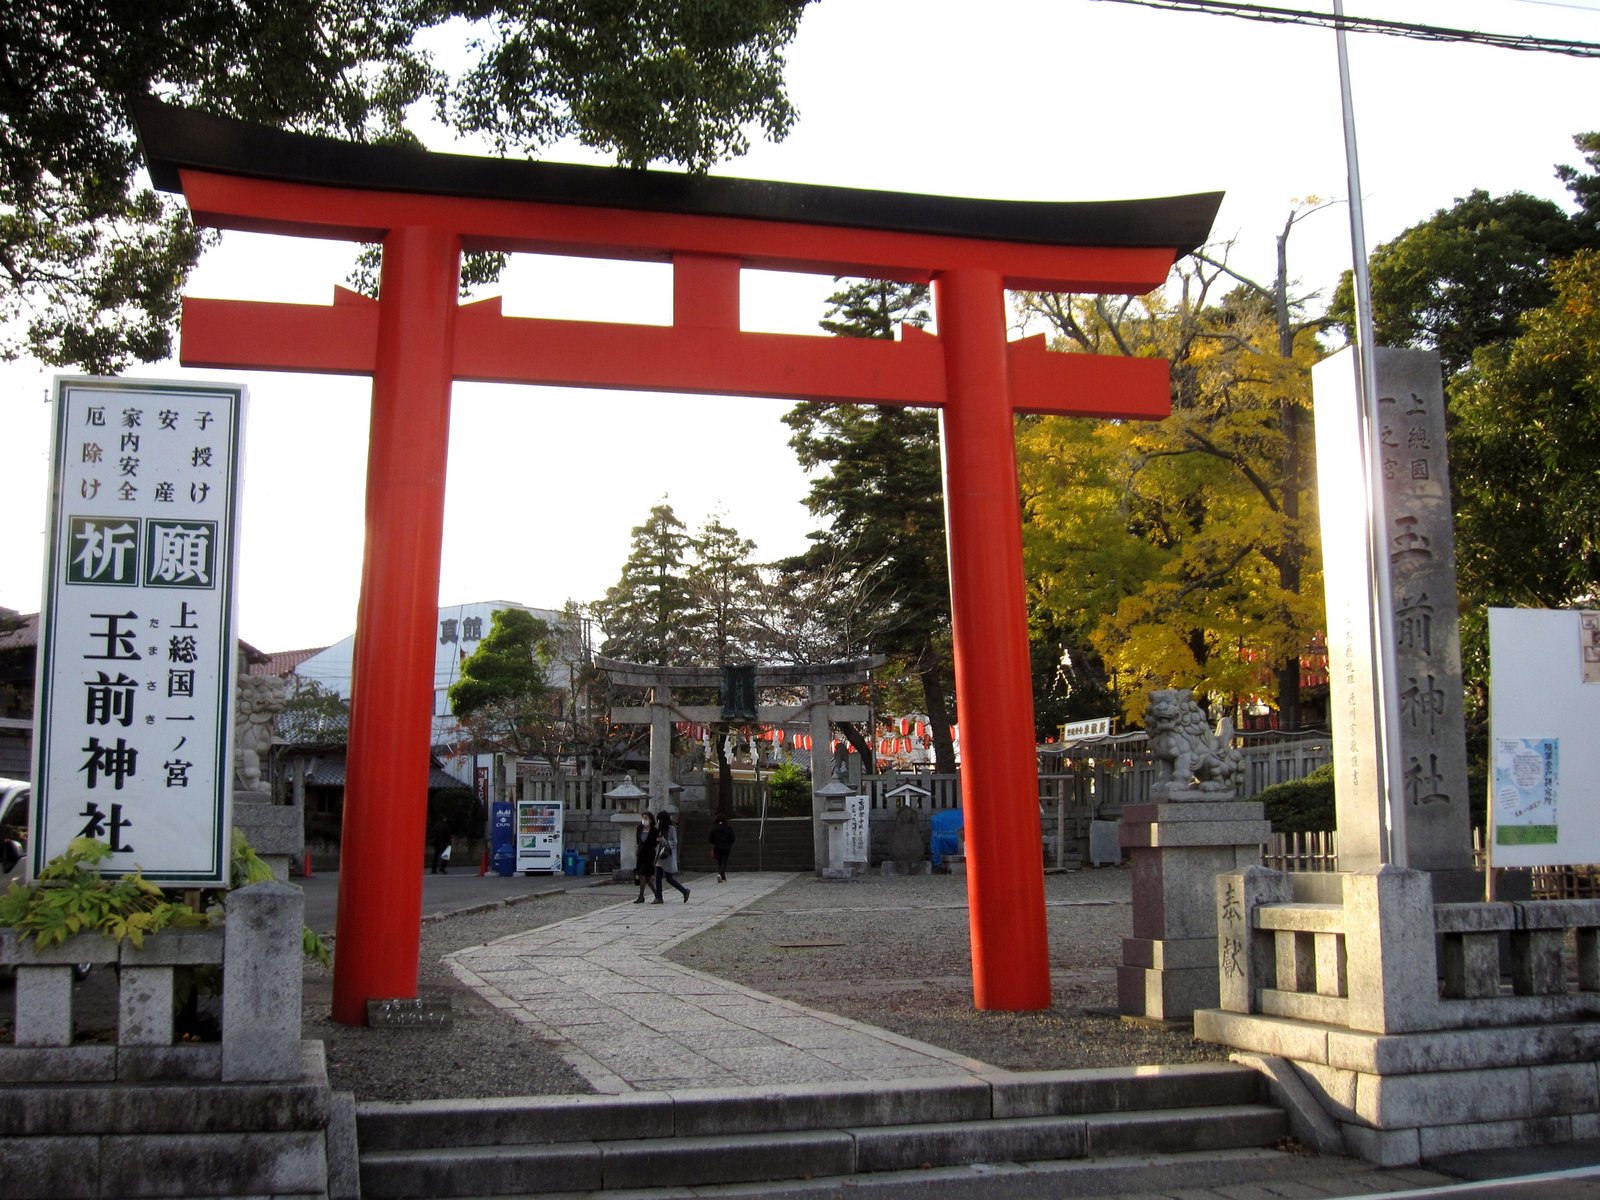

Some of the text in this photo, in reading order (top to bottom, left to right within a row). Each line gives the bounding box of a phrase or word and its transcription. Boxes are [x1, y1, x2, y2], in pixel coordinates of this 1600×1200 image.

[80, 406, 106, 501] 厄除け
[118, 407, 143, 502] 家内安全
[154, 409, 179, 503] 安産
[189, 411, 215, 504] 子授け
[1378, 397, 1399, 481] 一之宮
[1406, 392, 1430, 481] 上總國
[71, 522, 211, 584] 祈願
[145, 617, 160, 725] たまさき
[163, 601, 199, 789] 上総国一ノ宮
[1390, 515, 1450, 806] 玉前神社
[76, 610, 142, 854] 玉前神社
